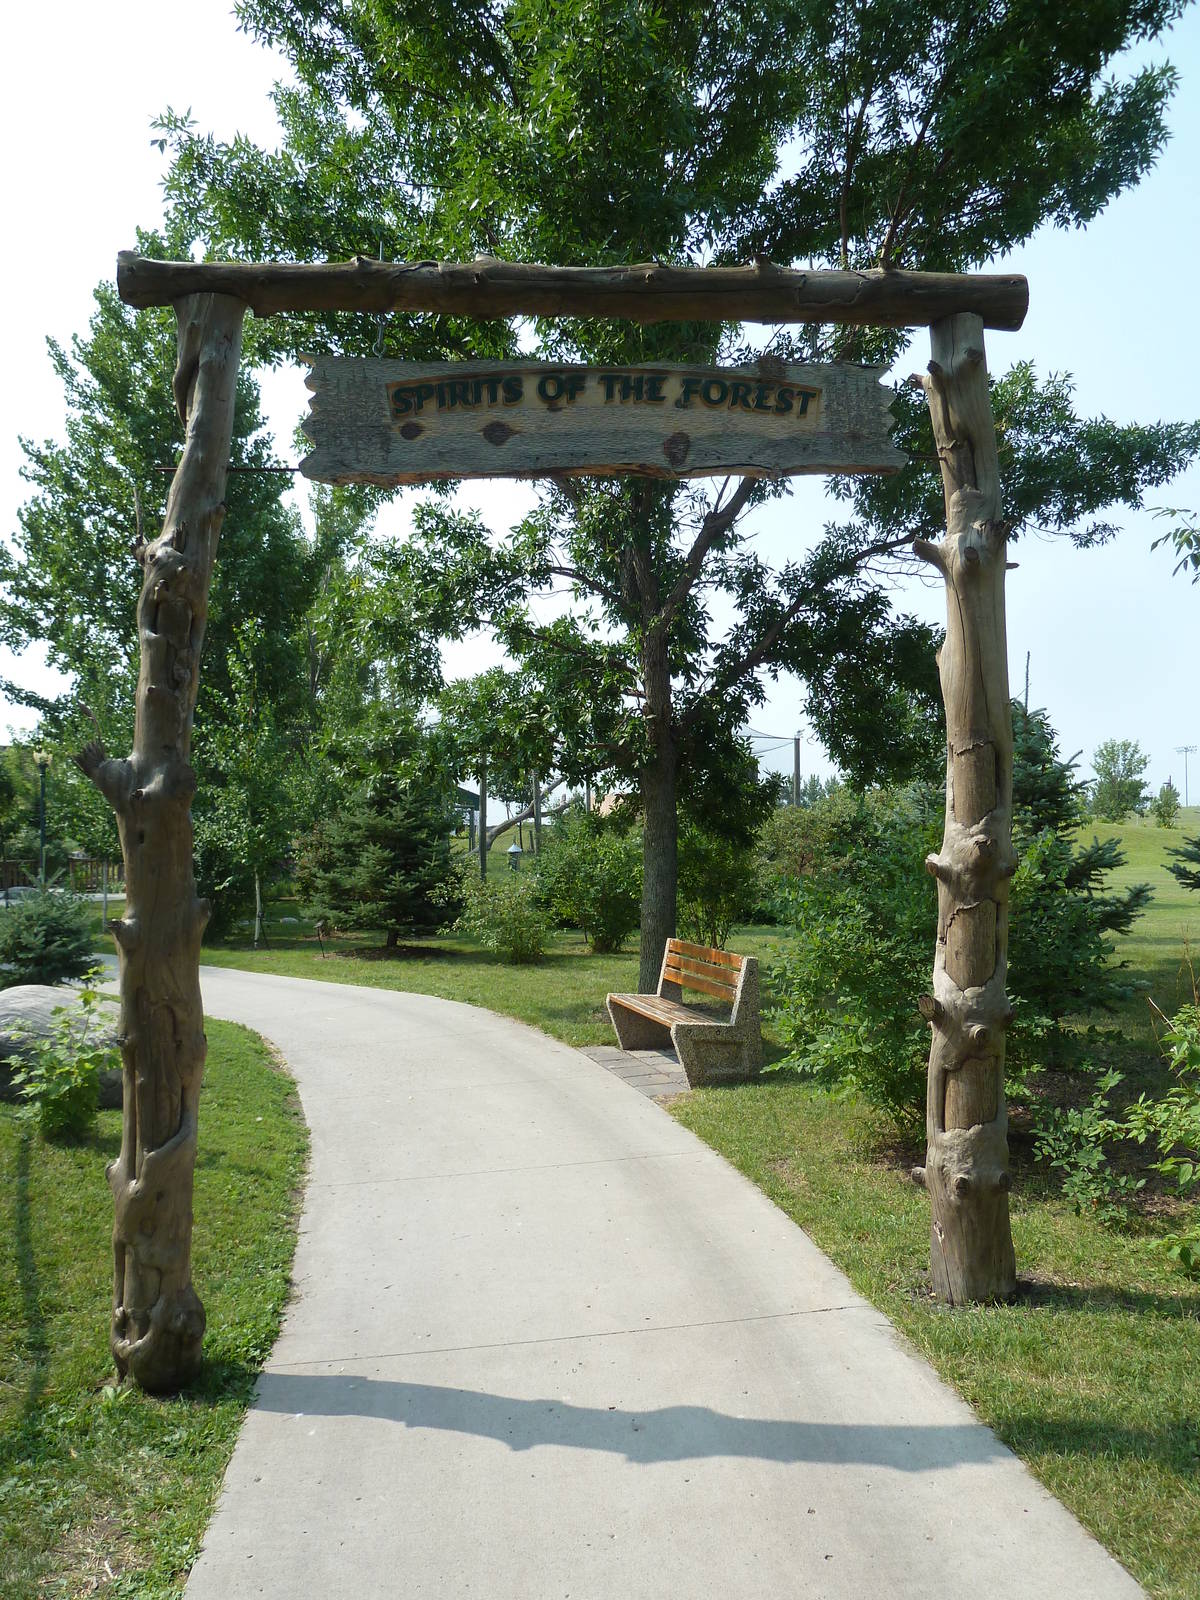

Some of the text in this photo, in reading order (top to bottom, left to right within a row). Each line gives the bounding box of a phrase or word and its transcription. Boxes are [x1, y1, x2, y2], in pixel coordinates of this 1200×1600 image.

[392, 374, 817, 415] SPIRITS OF THE FOREST
